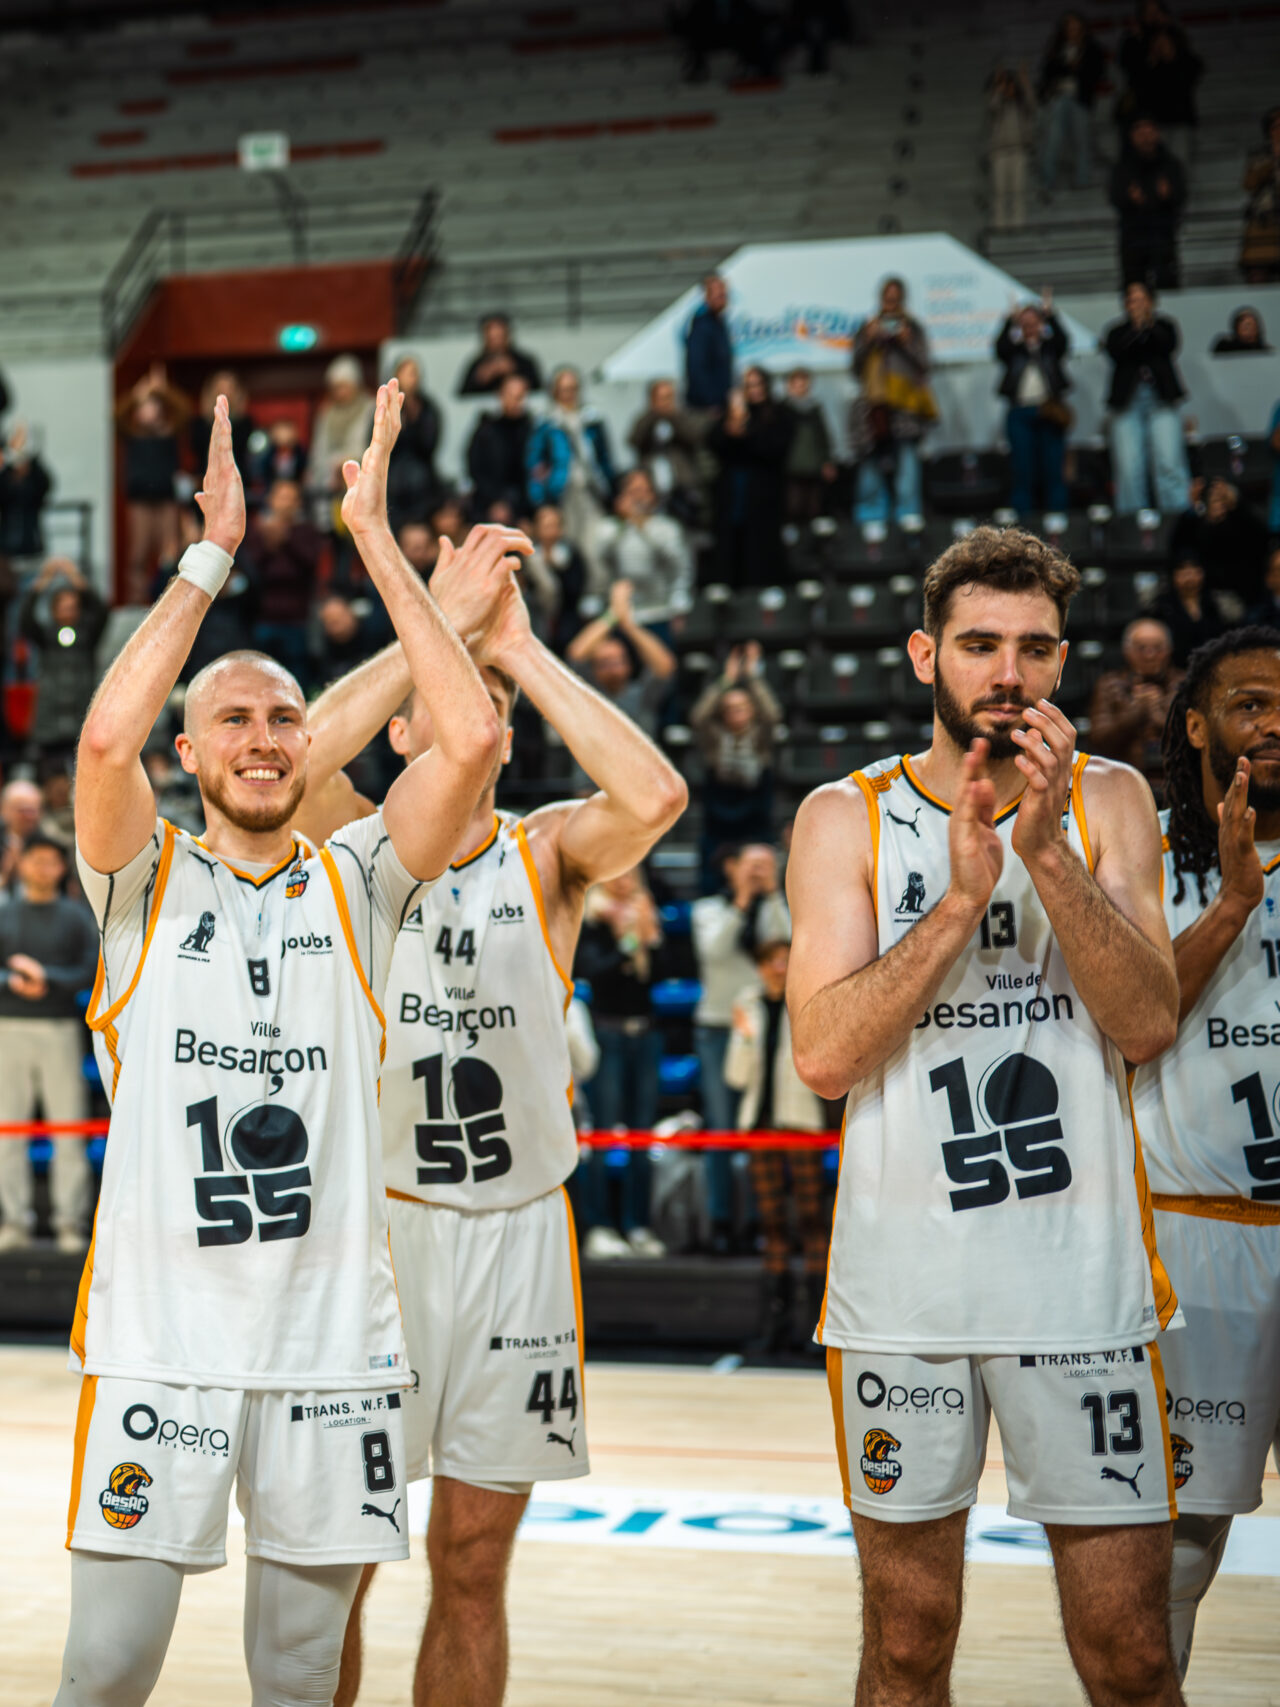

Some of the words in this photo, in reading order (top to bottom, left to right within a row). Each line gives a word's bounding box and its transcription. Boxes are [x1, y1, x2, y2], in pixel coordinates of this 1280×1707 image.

[488, 902, 524, 920] ubs
[980, 900, 1017, 950] 13
[434, 925, 477, 966] 44
[1260, 939, 1280, 979] 1
[247, 957, 271, 996] 8
[986, 974, 1023, 990] Ville
[1026, 972, 1042, 987] de
[250, 1020, 281, 1038] Ville
[914, 993, 1074, 1030] esanon
[414, 1113, 512, 1185] 55
[941, 1118, 1072, 1212] 55
[194, 1165, 312, 1248] 55
[1038, 1354, 1096, 1366] TRANS.
[1103, 1350, 1132, 1364] W.F.
[1070, 1368, 1109, 1377] LOCATION
[304, 1402, 355, 1419] TRANS.
[361, 1397, 387, 1412] W.F.
[525, 1366, 579, 1425] 44
[857, 1371, 964, 1411] Opera
[122, 1403, 229, 1451] Opera
[329, 1417, 367, 1427] LOCATION
[1080, 1389, 1145, 1456] 13
[164, 1441, 229, 1457] TELECOM
[360, 1429, 397, 1495] 8
